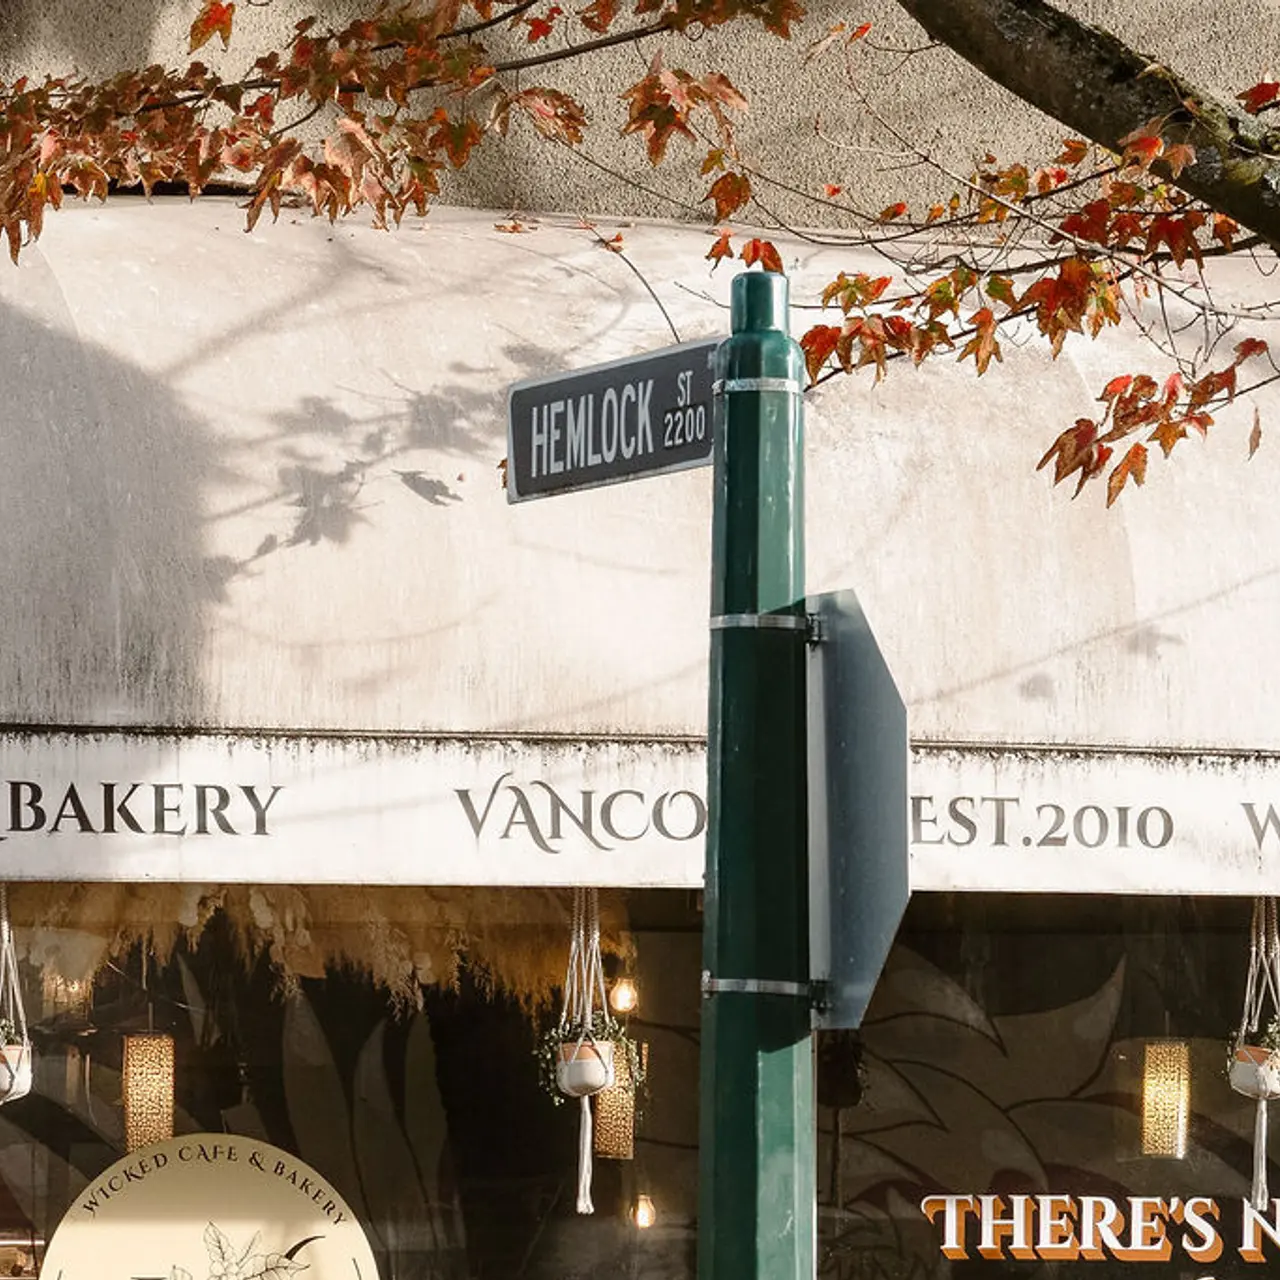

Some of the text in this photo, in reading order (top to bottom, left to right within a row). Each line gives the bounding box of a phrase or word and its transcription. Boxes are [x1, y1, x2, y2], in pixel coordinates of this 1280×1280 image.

[531, 370, 694, 478] HEMLOCK ST
[664, 406, 705, 447] 2200
[7, 780, 287, 837] BAKERY
[454, 772, 707, 855] VANCO
[82, 1144, 349, 1227] WICKED CAFE & BAKERY
[922, 1193, 1225, 1264] THERE'S
